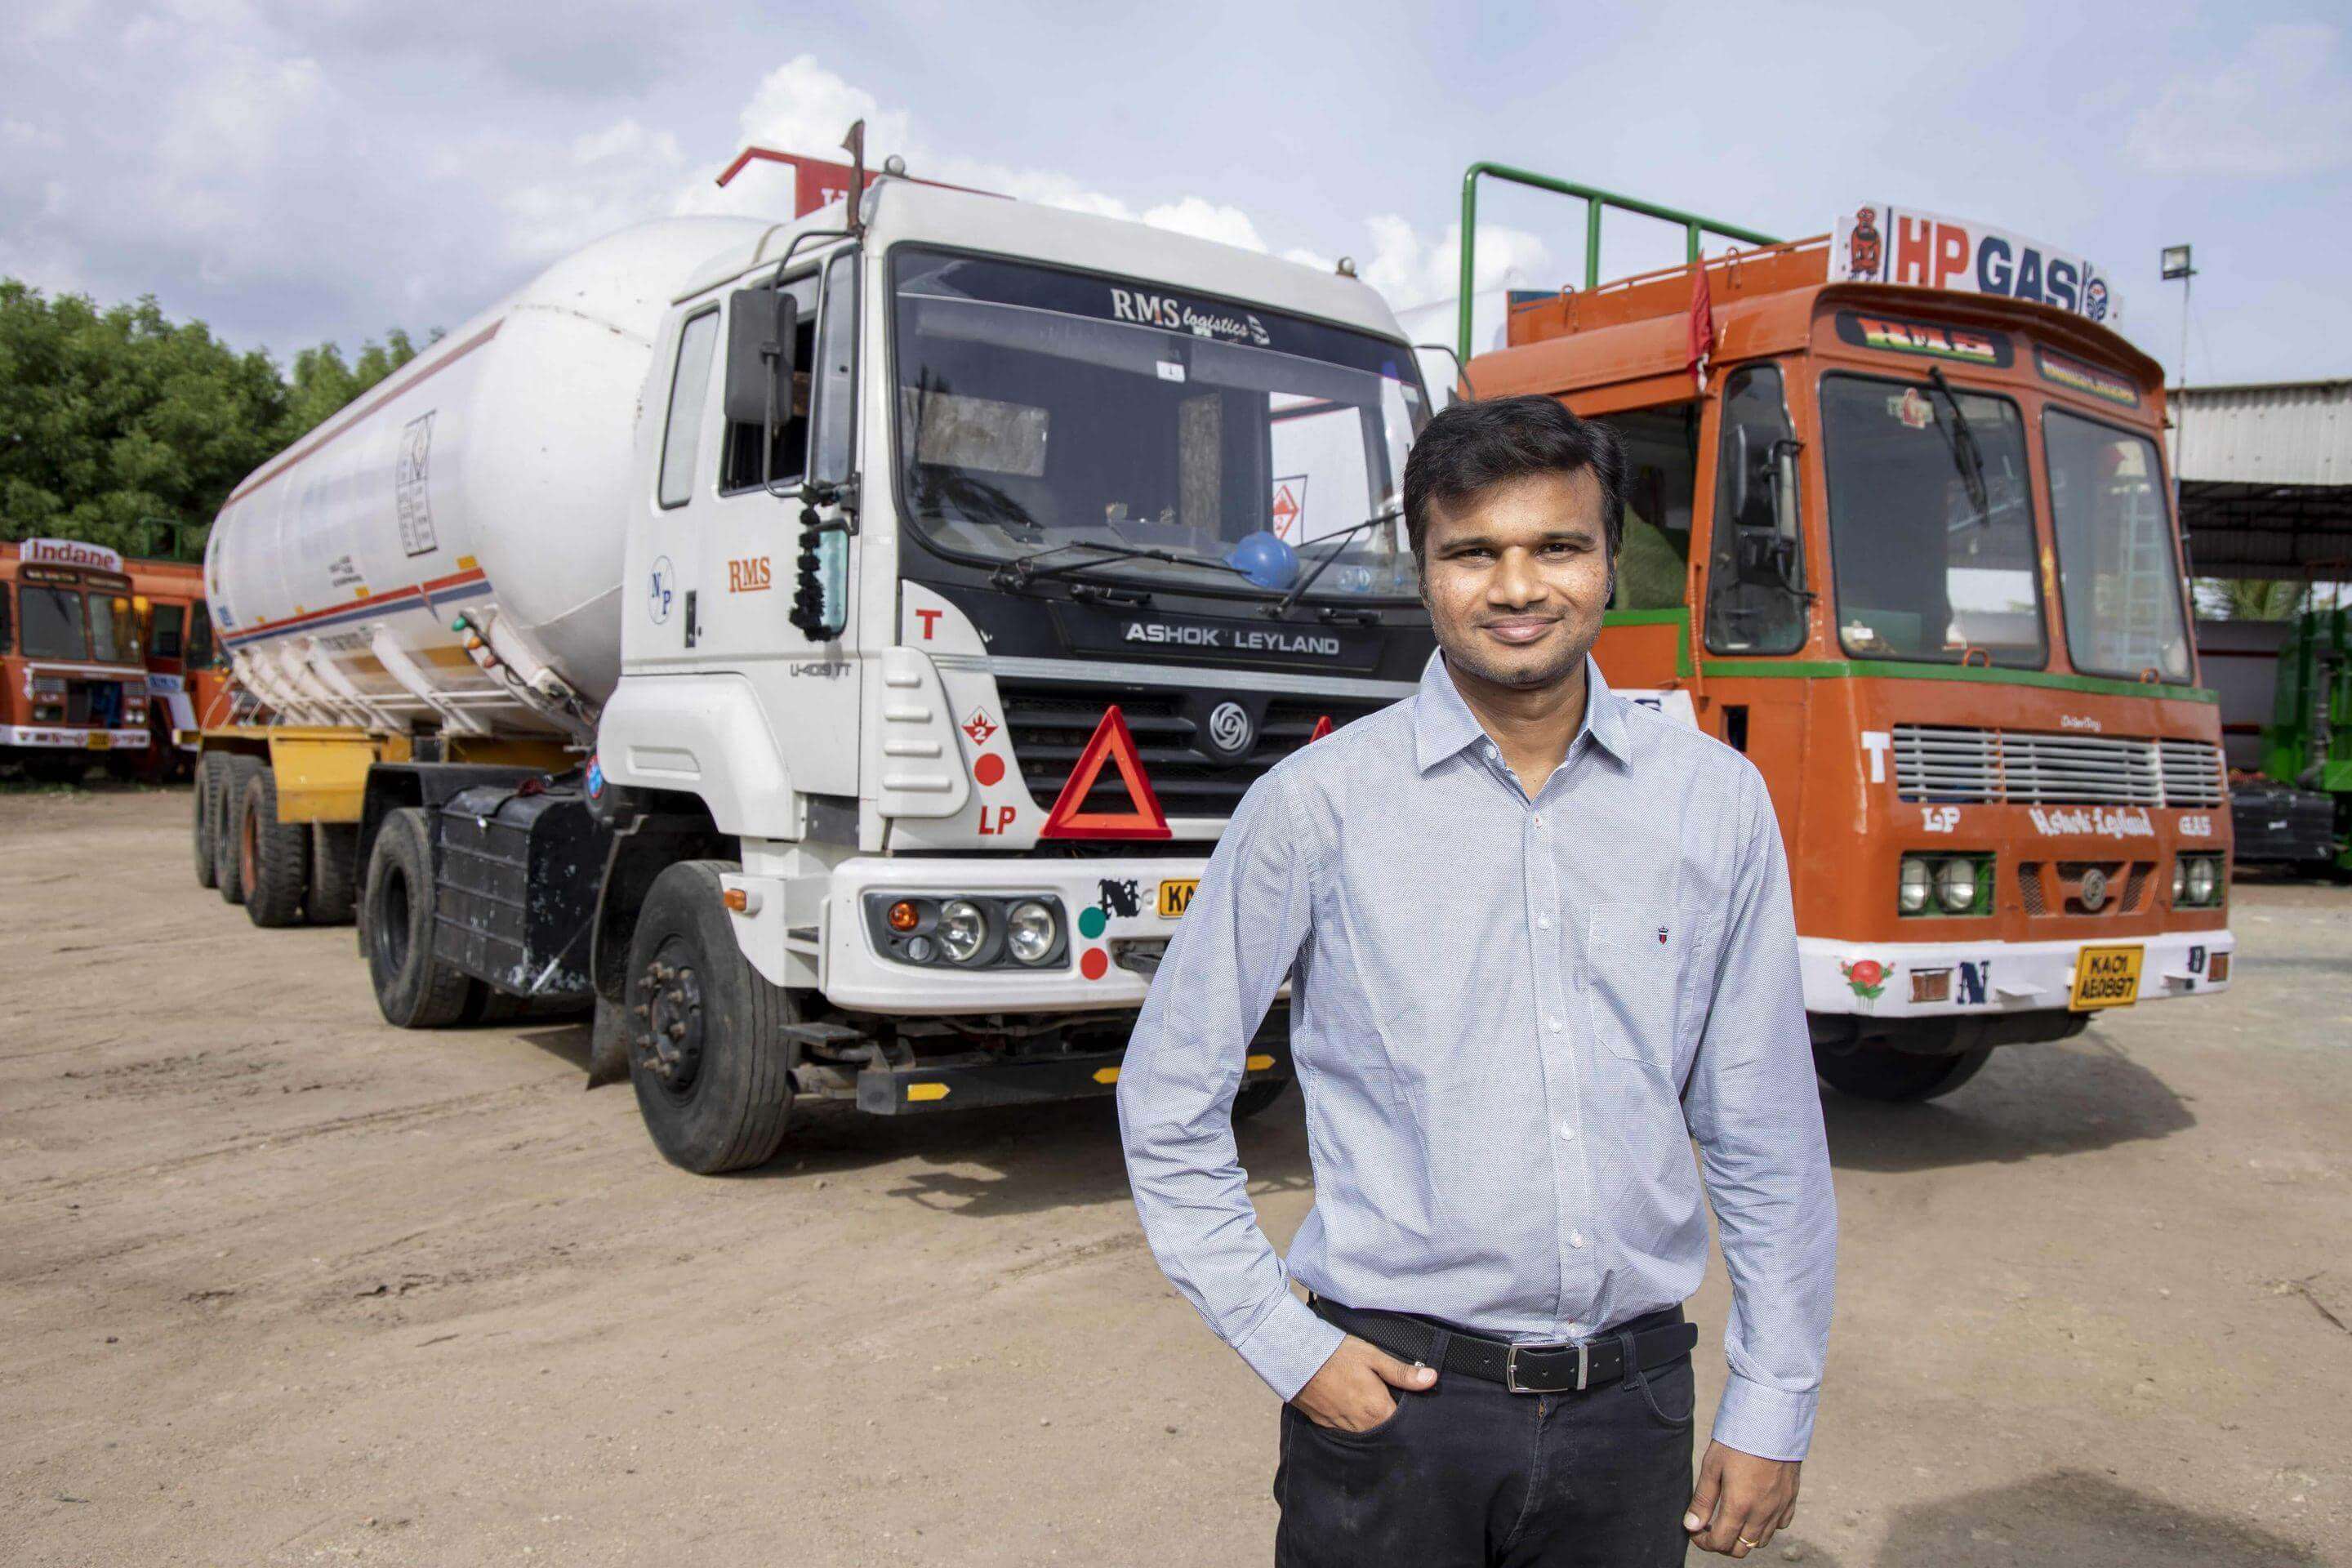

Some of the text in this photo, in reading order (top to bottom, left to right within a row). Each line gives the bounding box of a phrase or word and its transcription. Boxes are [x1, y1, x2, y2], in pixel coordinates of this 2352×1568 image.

[1896, 216, 2078, 312] HP GAS
[1111, 289, 1250, 337] RMS logistics
[33, 541, 114, 567] Indane
[728, 557, 771, 593] RMS
[915, 609, 942, 639] T
[1125, 623, 1339, 654] ASHOK LEYLAND
[1861, 732, 1891, 783] T
[978, 805, 1016, 835] LP
